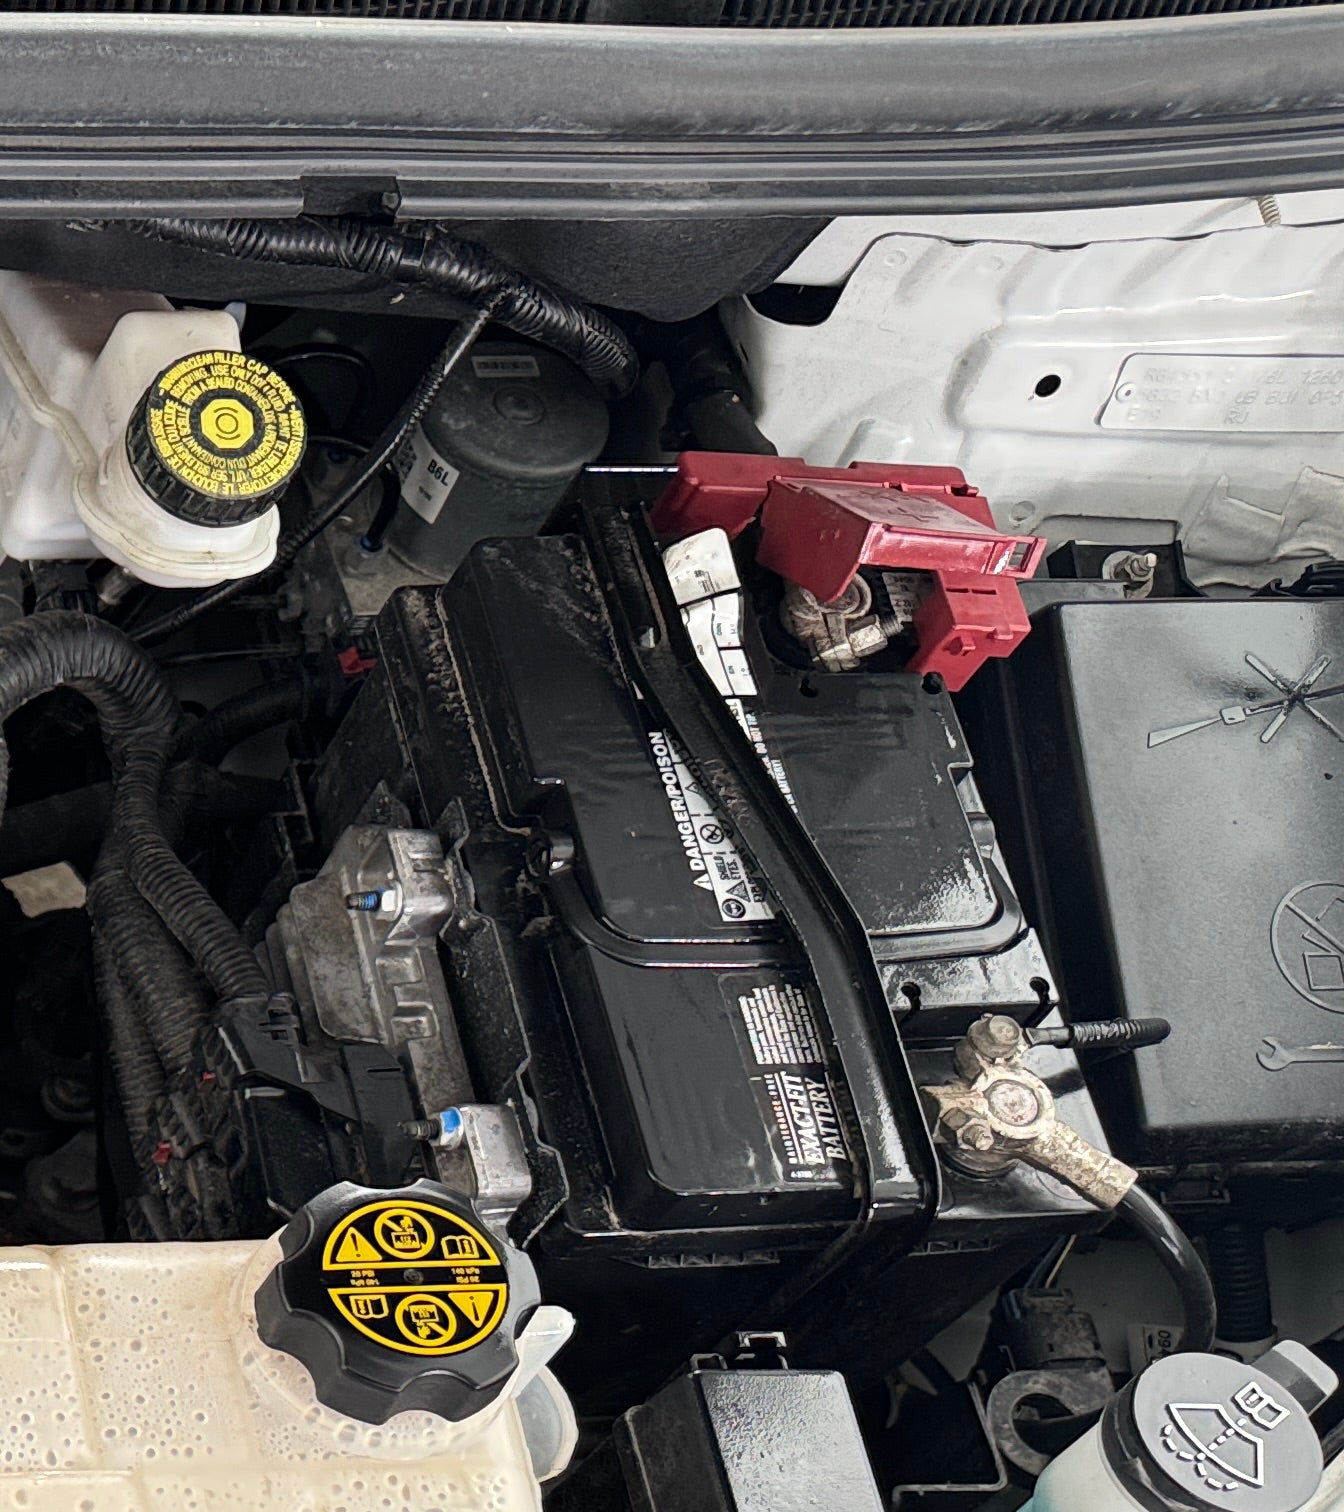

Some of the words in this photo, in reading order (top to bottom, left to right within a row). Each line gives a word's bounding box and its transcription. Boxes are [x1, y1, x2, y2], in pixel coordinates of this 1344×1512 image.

[210, 365, 229, 376] USE
[231, 366, 252, 380] ONLY
[214, 353, 246, 367] FILLER
[247, 361, 268, 375] CAP
[266, 373, 295, 404] BEFORE
[199, 382, 209, 392] A
[167, 454, 183, 470] DE
[427, 459, 449, 487] B6L
[178, 465, 220, 493] BOUCHON
[220, 483, 236, 494] LE
[648, 731, 706, 872] DANGER/POISON
[780, 1070, 826, 1165] EXACT-FIT
[805, 1077, 847, 1161] BATTERY
